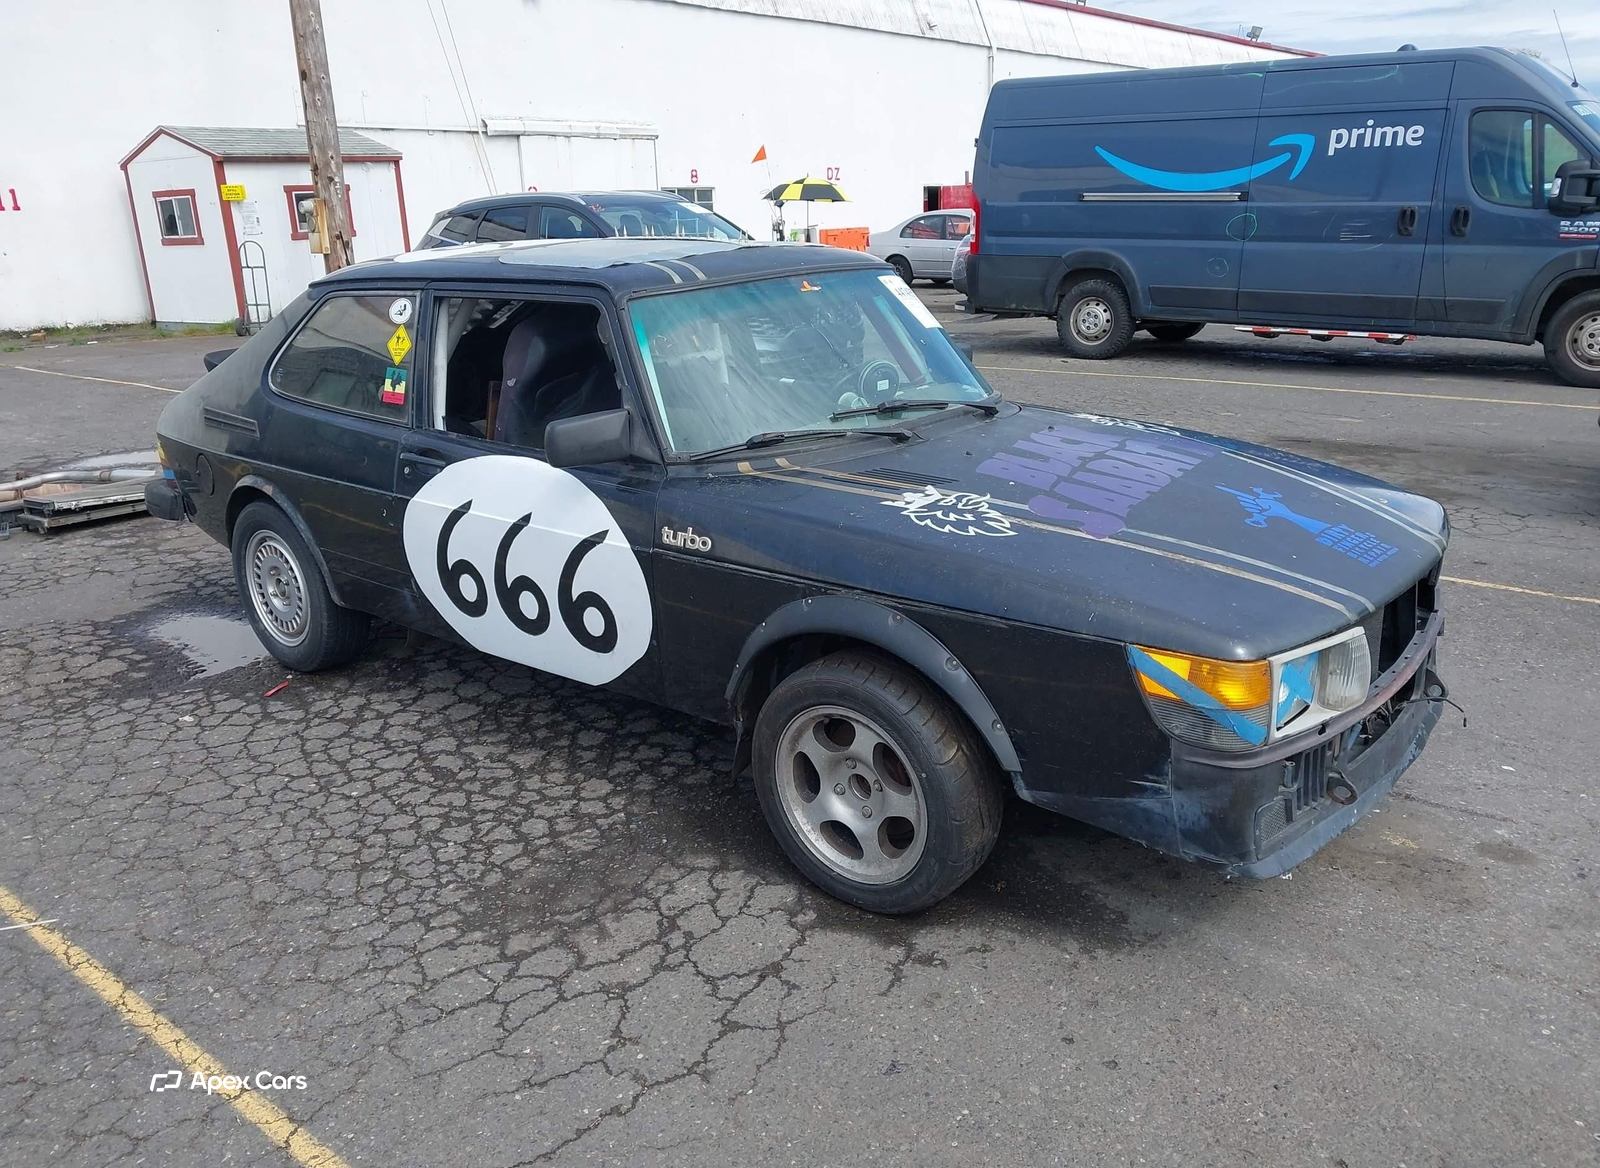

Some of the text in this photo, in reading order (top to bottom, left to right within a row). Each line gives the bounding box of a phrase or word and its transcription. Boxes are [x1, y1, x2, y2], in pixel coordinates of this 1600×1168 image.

[1327, 119, 1425, 156] prime
[690, 169, 699, 183] 8
[976, 424, 1127, 492] BLACK
[1028, 434, 1220, 539] SAABATH
[661, 526, 712, 552] turbo
[1315, 523, 1355, 547] DIRTY
[1358, 543, 1392, 565] REPAIR
[436, 499, 618, 654] 666
